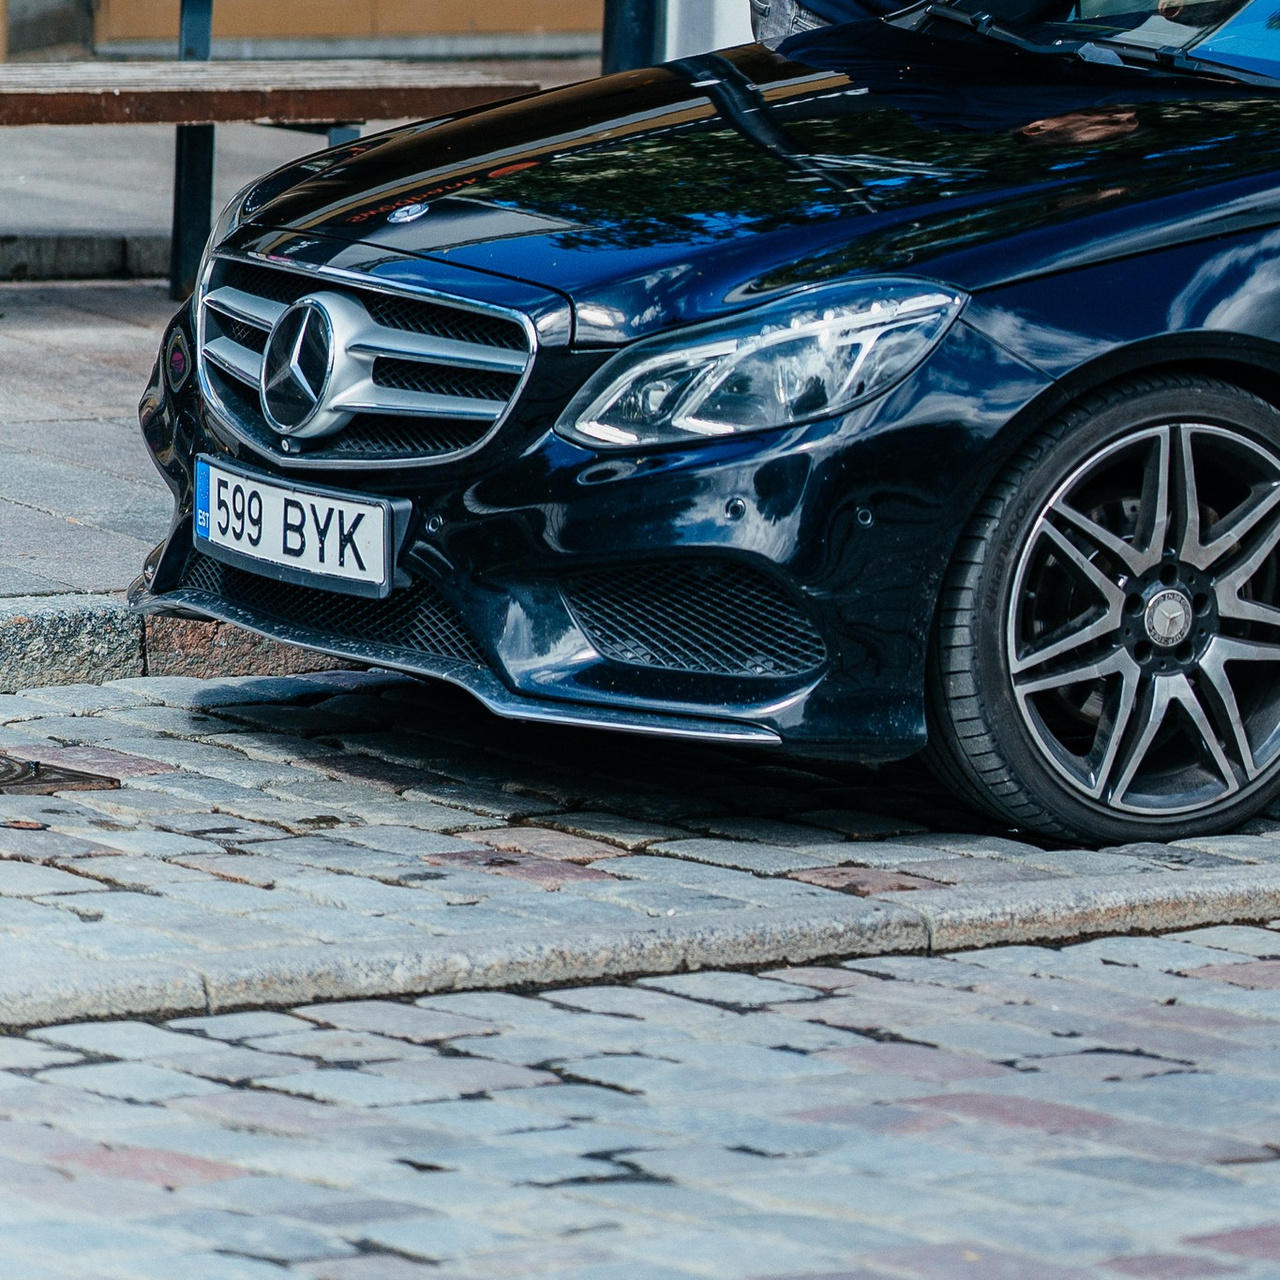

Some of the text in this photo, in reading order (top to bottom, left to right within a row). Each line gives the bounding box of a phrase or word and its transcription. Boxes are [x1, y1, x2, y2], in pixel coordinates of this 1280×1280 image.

[198, 509, 210, 528] EST
[217, 477, 367, 571] 599 BYK
